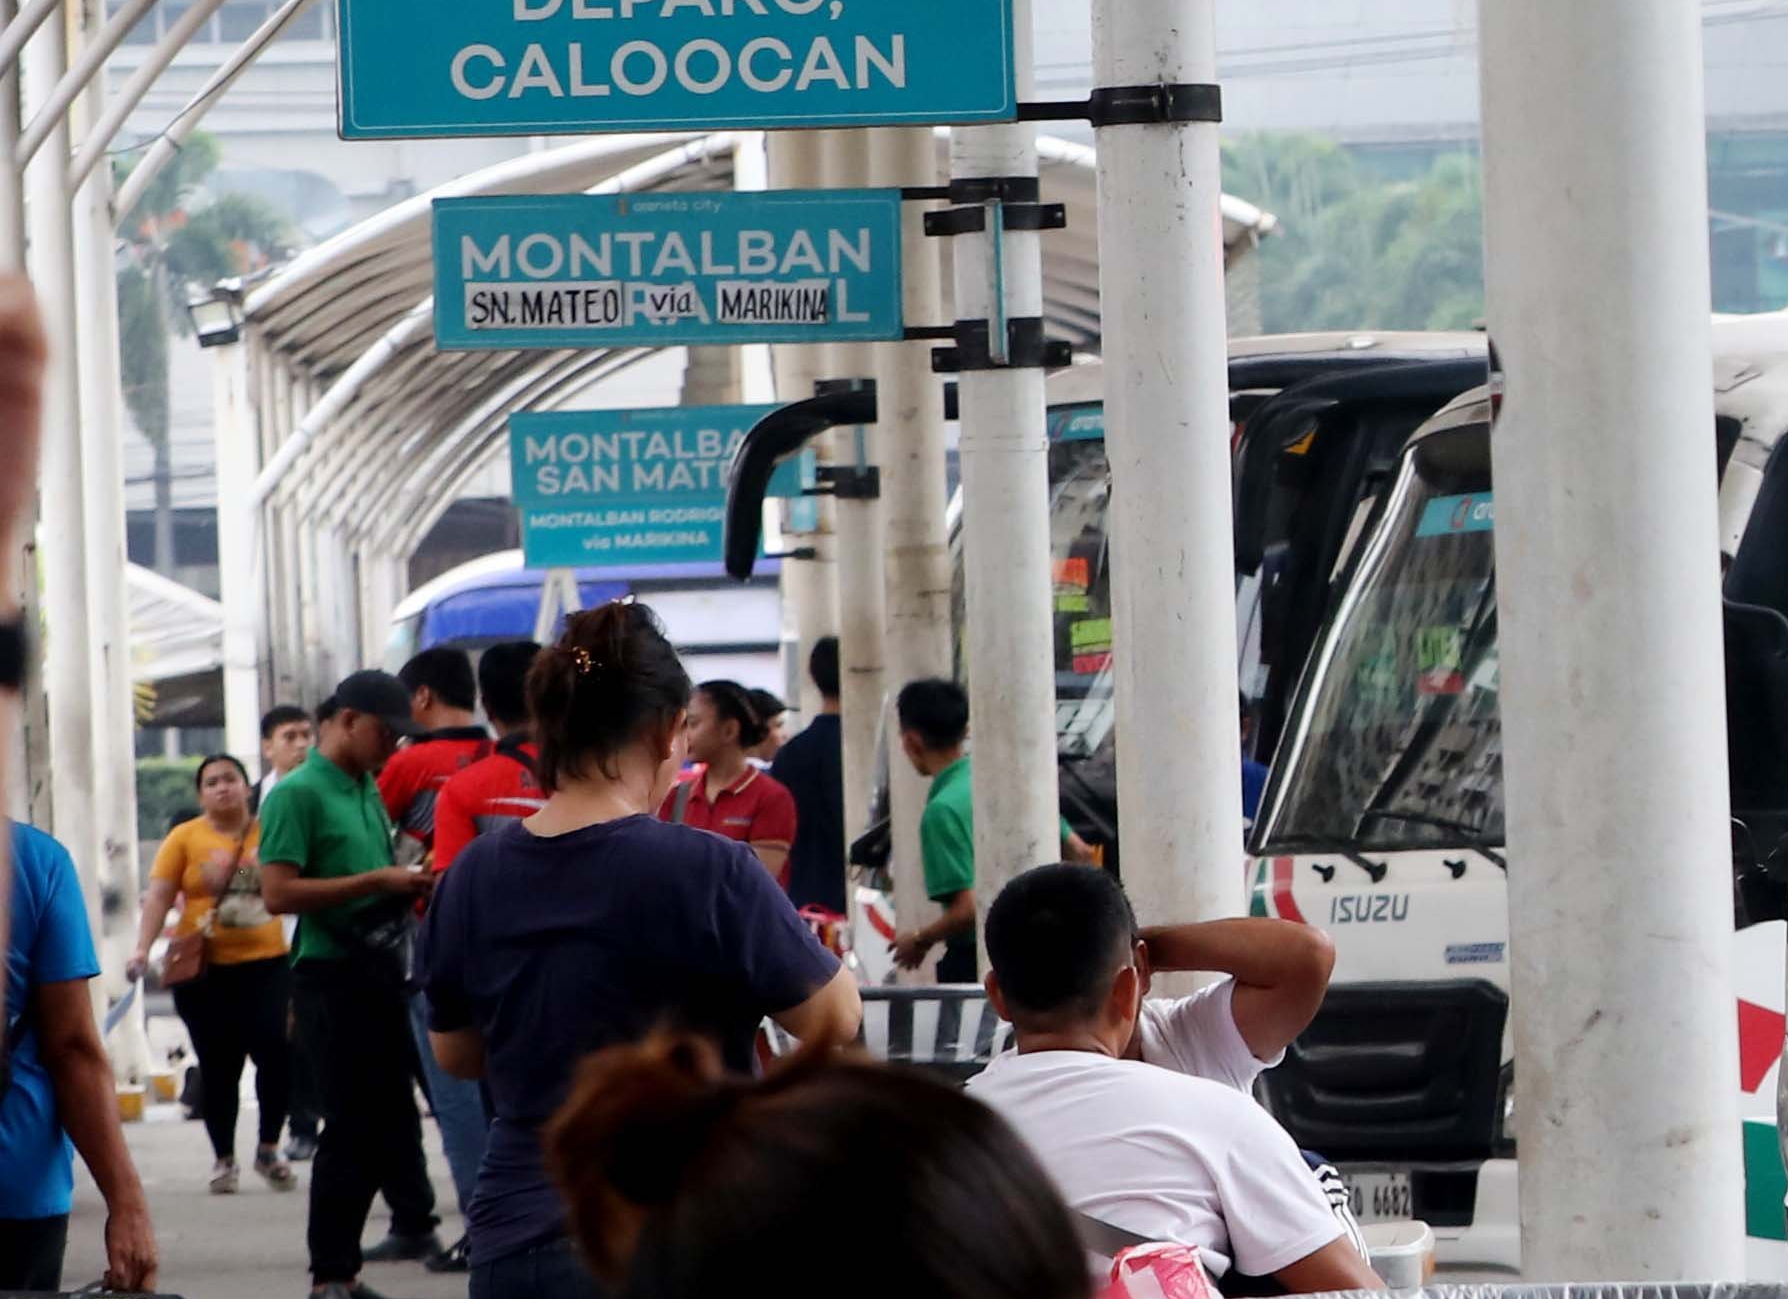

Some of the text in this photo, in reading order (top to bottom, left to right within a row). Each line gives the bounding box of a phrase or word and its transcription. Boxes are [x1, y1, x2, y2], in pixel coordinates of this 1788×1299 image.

[450, 33, 907, 101] CALOOCAN
[461, 227, 871, 280] MONTALBAN
[648, 285, 693, 317] via
[720, 286, 828, 325] MARIKINA
[525, 428, 748, 465] MONTALBA
[536, 464, 621, 495] SAN
[530, 509, 727, 529] MONTALBAN RODRIG
[1330, 894, 1410, 924] ISUZU
